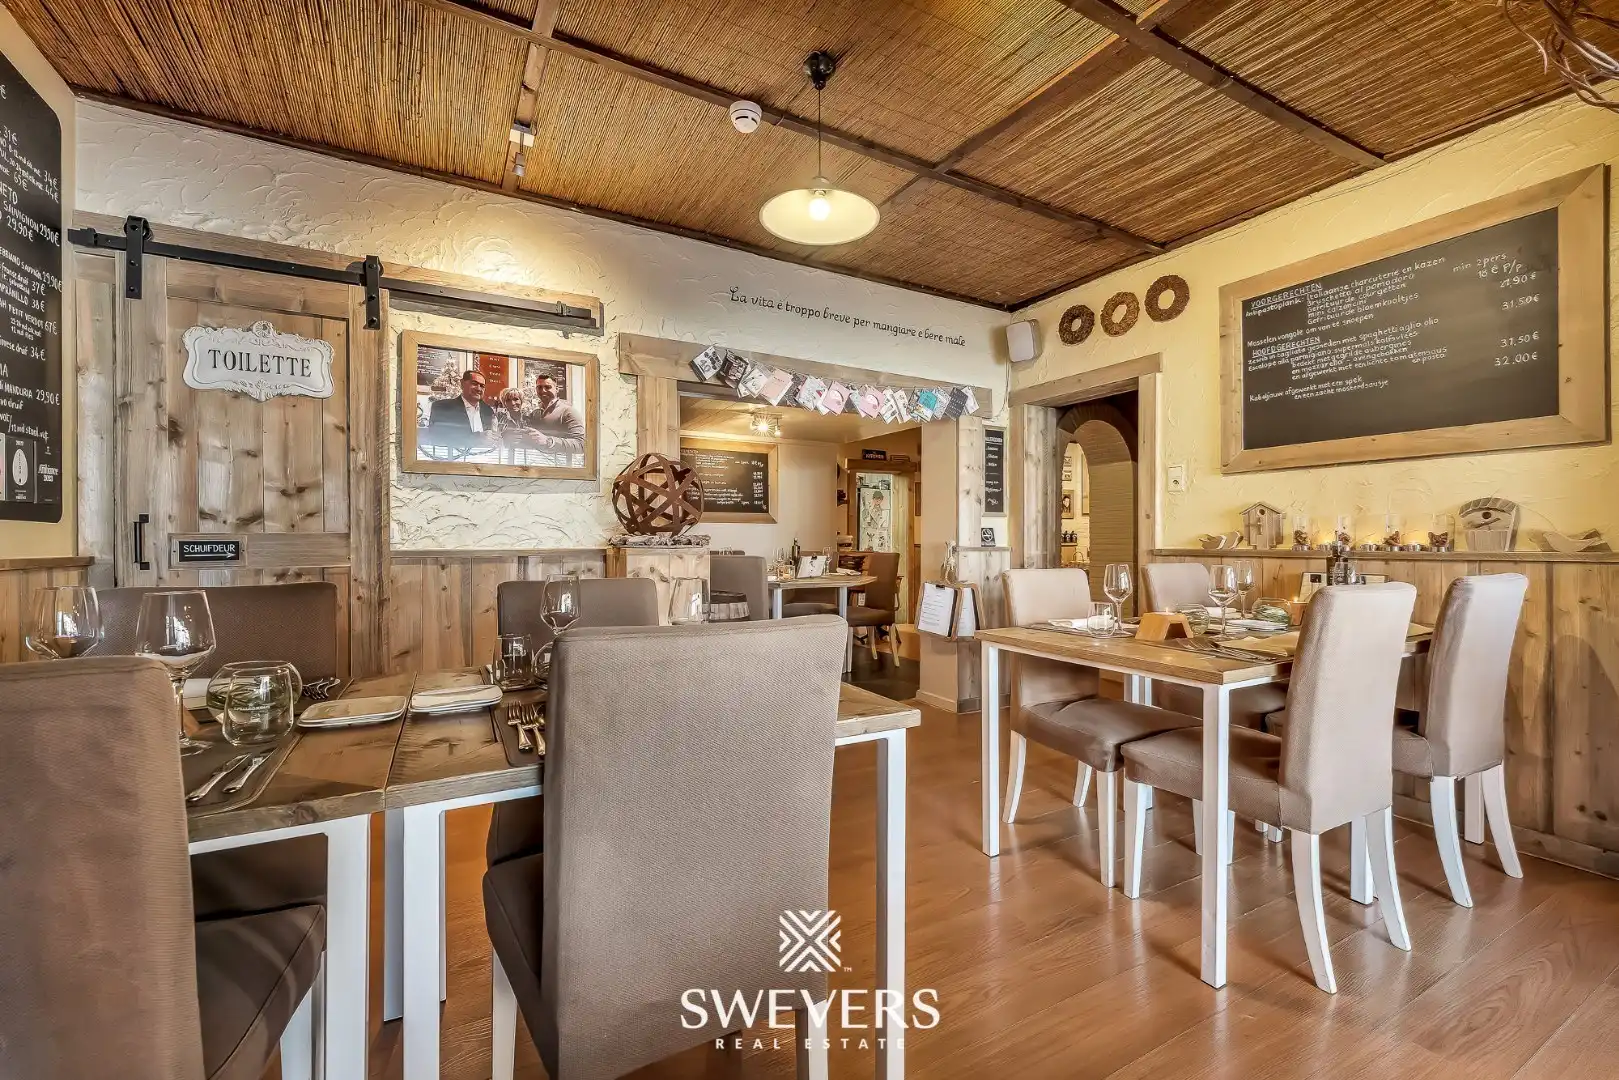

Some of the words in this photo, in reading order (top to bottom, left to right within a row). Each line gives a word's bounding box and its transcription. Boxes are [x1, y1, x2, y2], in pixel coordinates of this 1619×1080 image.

[13, 171, 28, 192] 65€
[6, 215, 34, 242] 29.90€
[1351, 269, 1400, 289] charcuterie
[1402, 266, 1412, 274] en
[1452, 261, 1472, 273] min
[1365, 273, 1415, 291] pomodoro
[1251, 282, 1323, 309] VOORGERECHTEN
[729, 285, 748, 304] La
[751, 295, 775, 308] vita
[785, 300, 821, 319] troppo
[822, 306, 851, 324] breve
[853, 317, 871, 329] per
[873, 321, 917, 337] mangiare
[918, 330, 923, 338] e
[924, 328, 943, 342] bere
[945, 335, 966, 347] male
[1342, 313, 1374, 326] snoepen
[1252, 336, 1321, 358] HOOFDGERECHTEN
[207, 349, 312, 377] TOILETTE
[183, 544, 236, 553] SCHUIFDEUR
